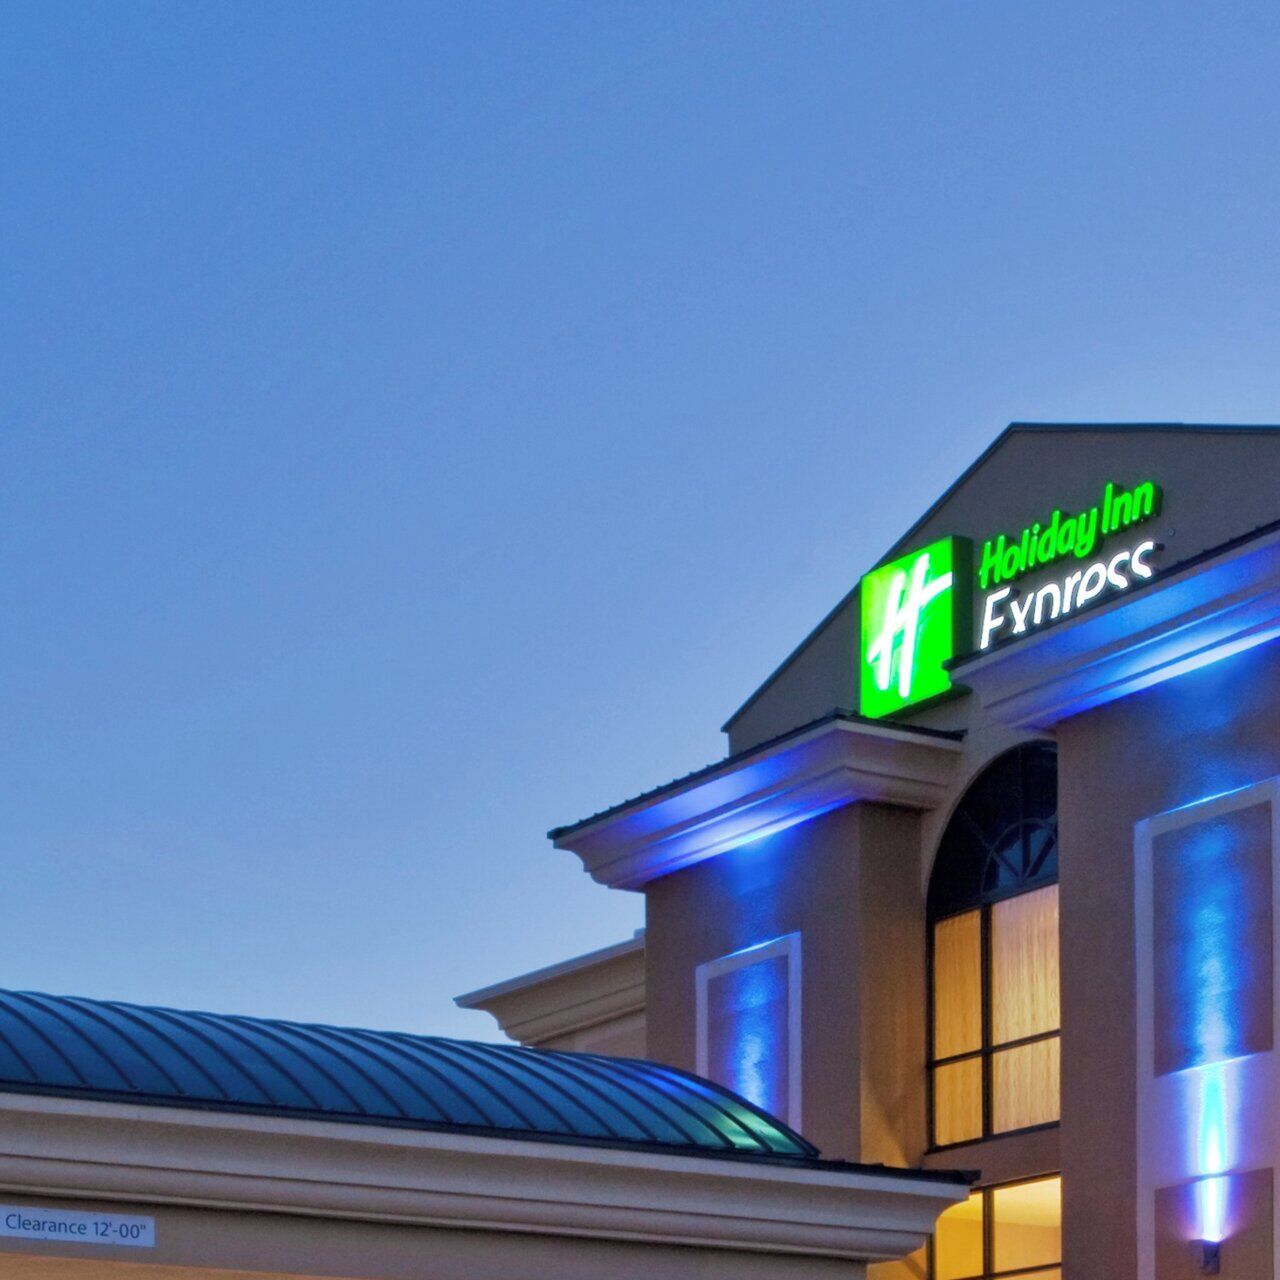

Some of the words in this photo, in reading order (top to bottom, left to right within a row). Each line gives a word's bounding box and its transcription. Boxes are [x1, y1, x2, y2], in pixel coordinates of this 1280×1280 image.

[979, 508, 1098, 589] Holiday
[1101, 480, 1155, 535] Inn
[5, 1213, 88, 1236] Clearance
[93, 1221, 147, 1239] 12'-00"
